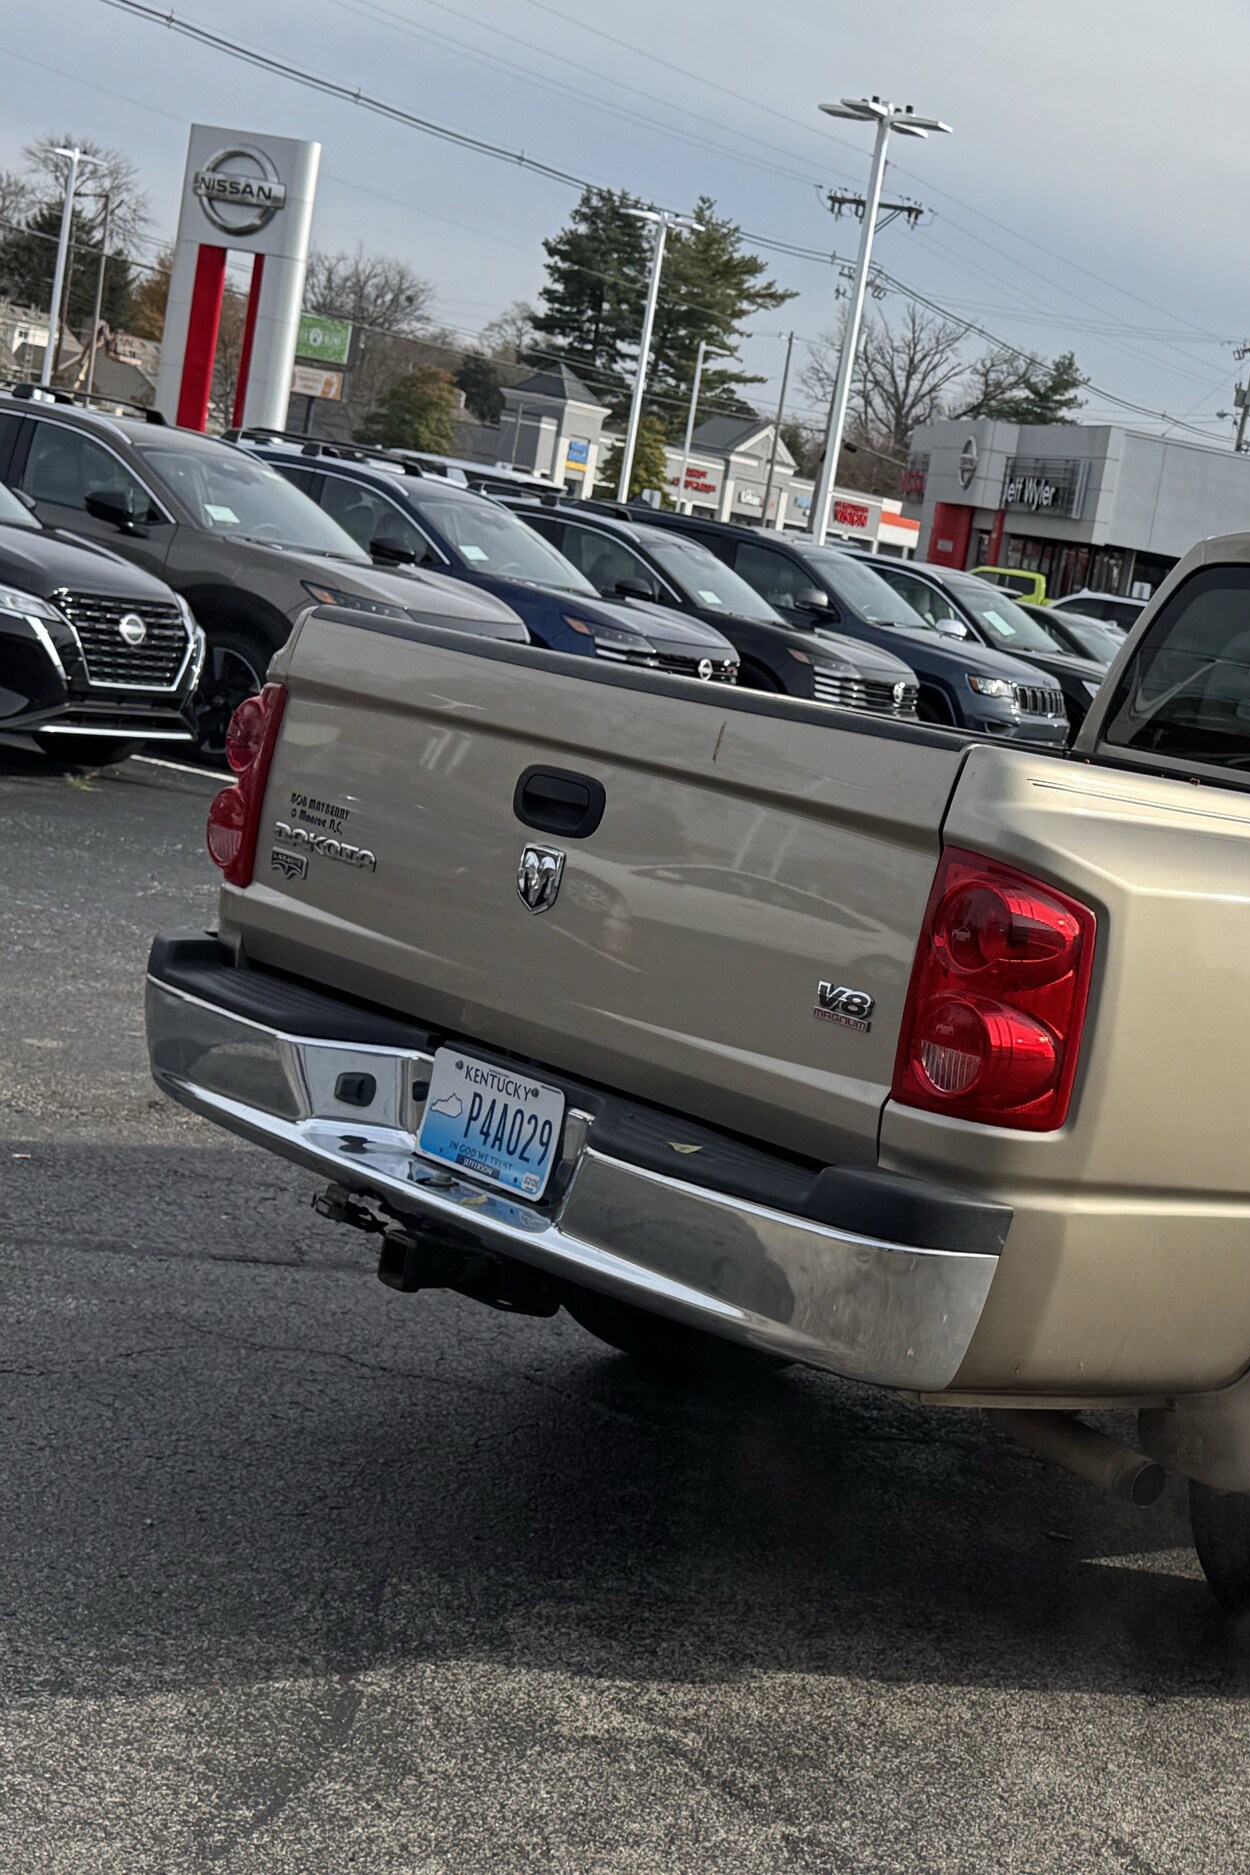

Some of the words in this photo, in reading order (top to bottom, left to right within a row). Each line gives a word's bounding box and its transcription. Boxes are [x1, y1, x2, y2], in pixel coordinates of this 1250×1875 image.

[200, 177, 272, 200] NISSAN
[1002, 476, 1022, 503] Jeff
[1024, 478, 1055, 510] Wyler
[274, 821, 376, 873] DAKOTA
[818, 980, 873, 1018] V8
[813, 1007, 867, 1031] MAGNUM
[465, 1064, 532, 1102] KENTUCKY
[463, 1091, 553, 1166] P4A029
[449, 1140, 458, 1149] IN
[460, 1144, 477, 1157] GOD
[478, 1150, 490, 1162] WE
[490, 1153, 513, 1171] TRUST
[463, 1157, 494, 1175] JEFFERSON
